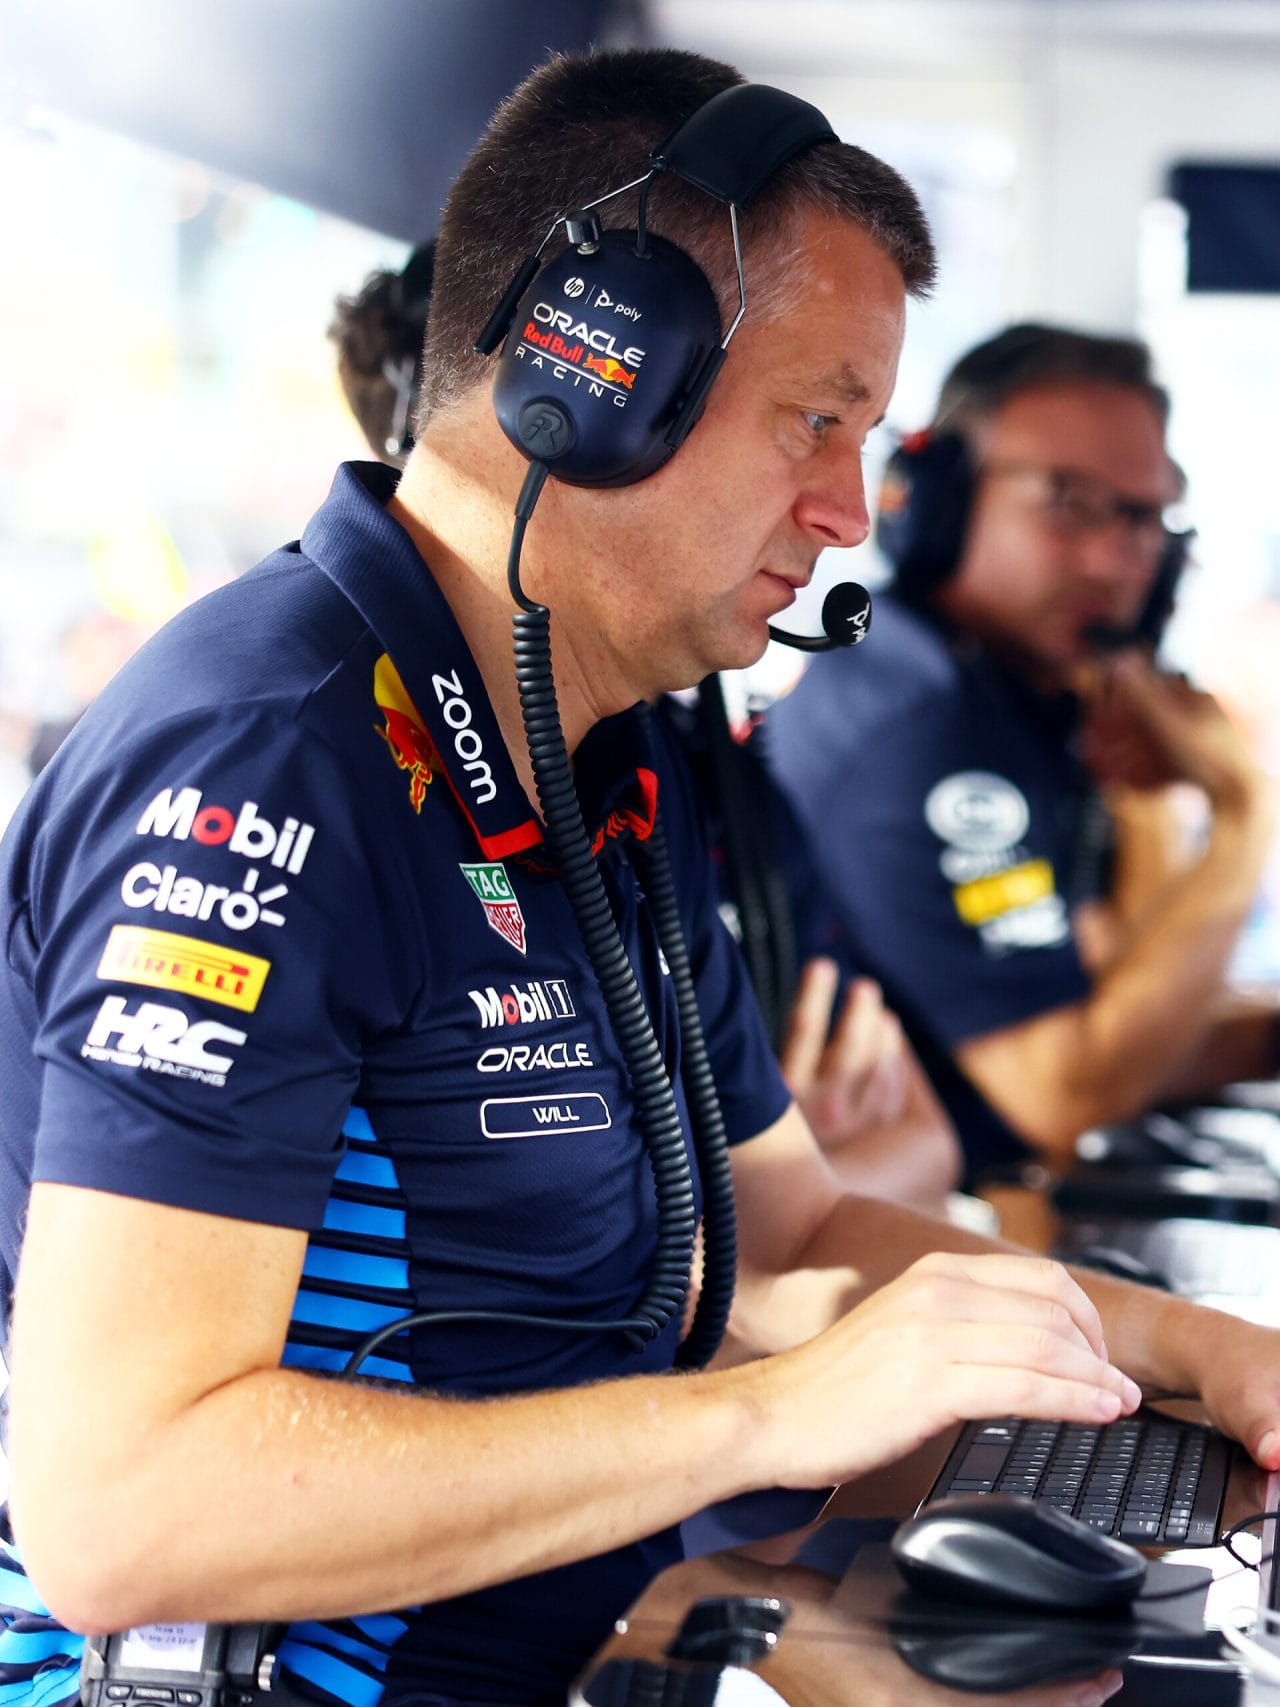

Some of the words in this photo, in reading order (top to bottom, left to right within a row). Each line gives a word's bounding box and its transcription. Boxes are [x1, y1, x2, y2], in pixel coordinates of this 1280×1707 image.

[564, 277, 585, 297] hp
[614, 304, 642, 322] poly
[533, 302, 646, 368] ORACLE
[515, 346, 628, 408] RACING
[431, 668, 497, 804] zoom
[136, 786, 316, 875] Mobil
[121, 862, 260, 931] Claro
[464, 869, 511, 897] TAG
[117, 941, 251, 997] PIRELLI
[468, 981, 552, 1028] Mobil
[551, 982, 570, 1015] 1
[86, 994, 248, 1075] HRC
[477, 1043, 593, 1073] ORACLE
[142, 1055, 228, 1088] RACING
[532, 1105, 580, 1124] WILL
